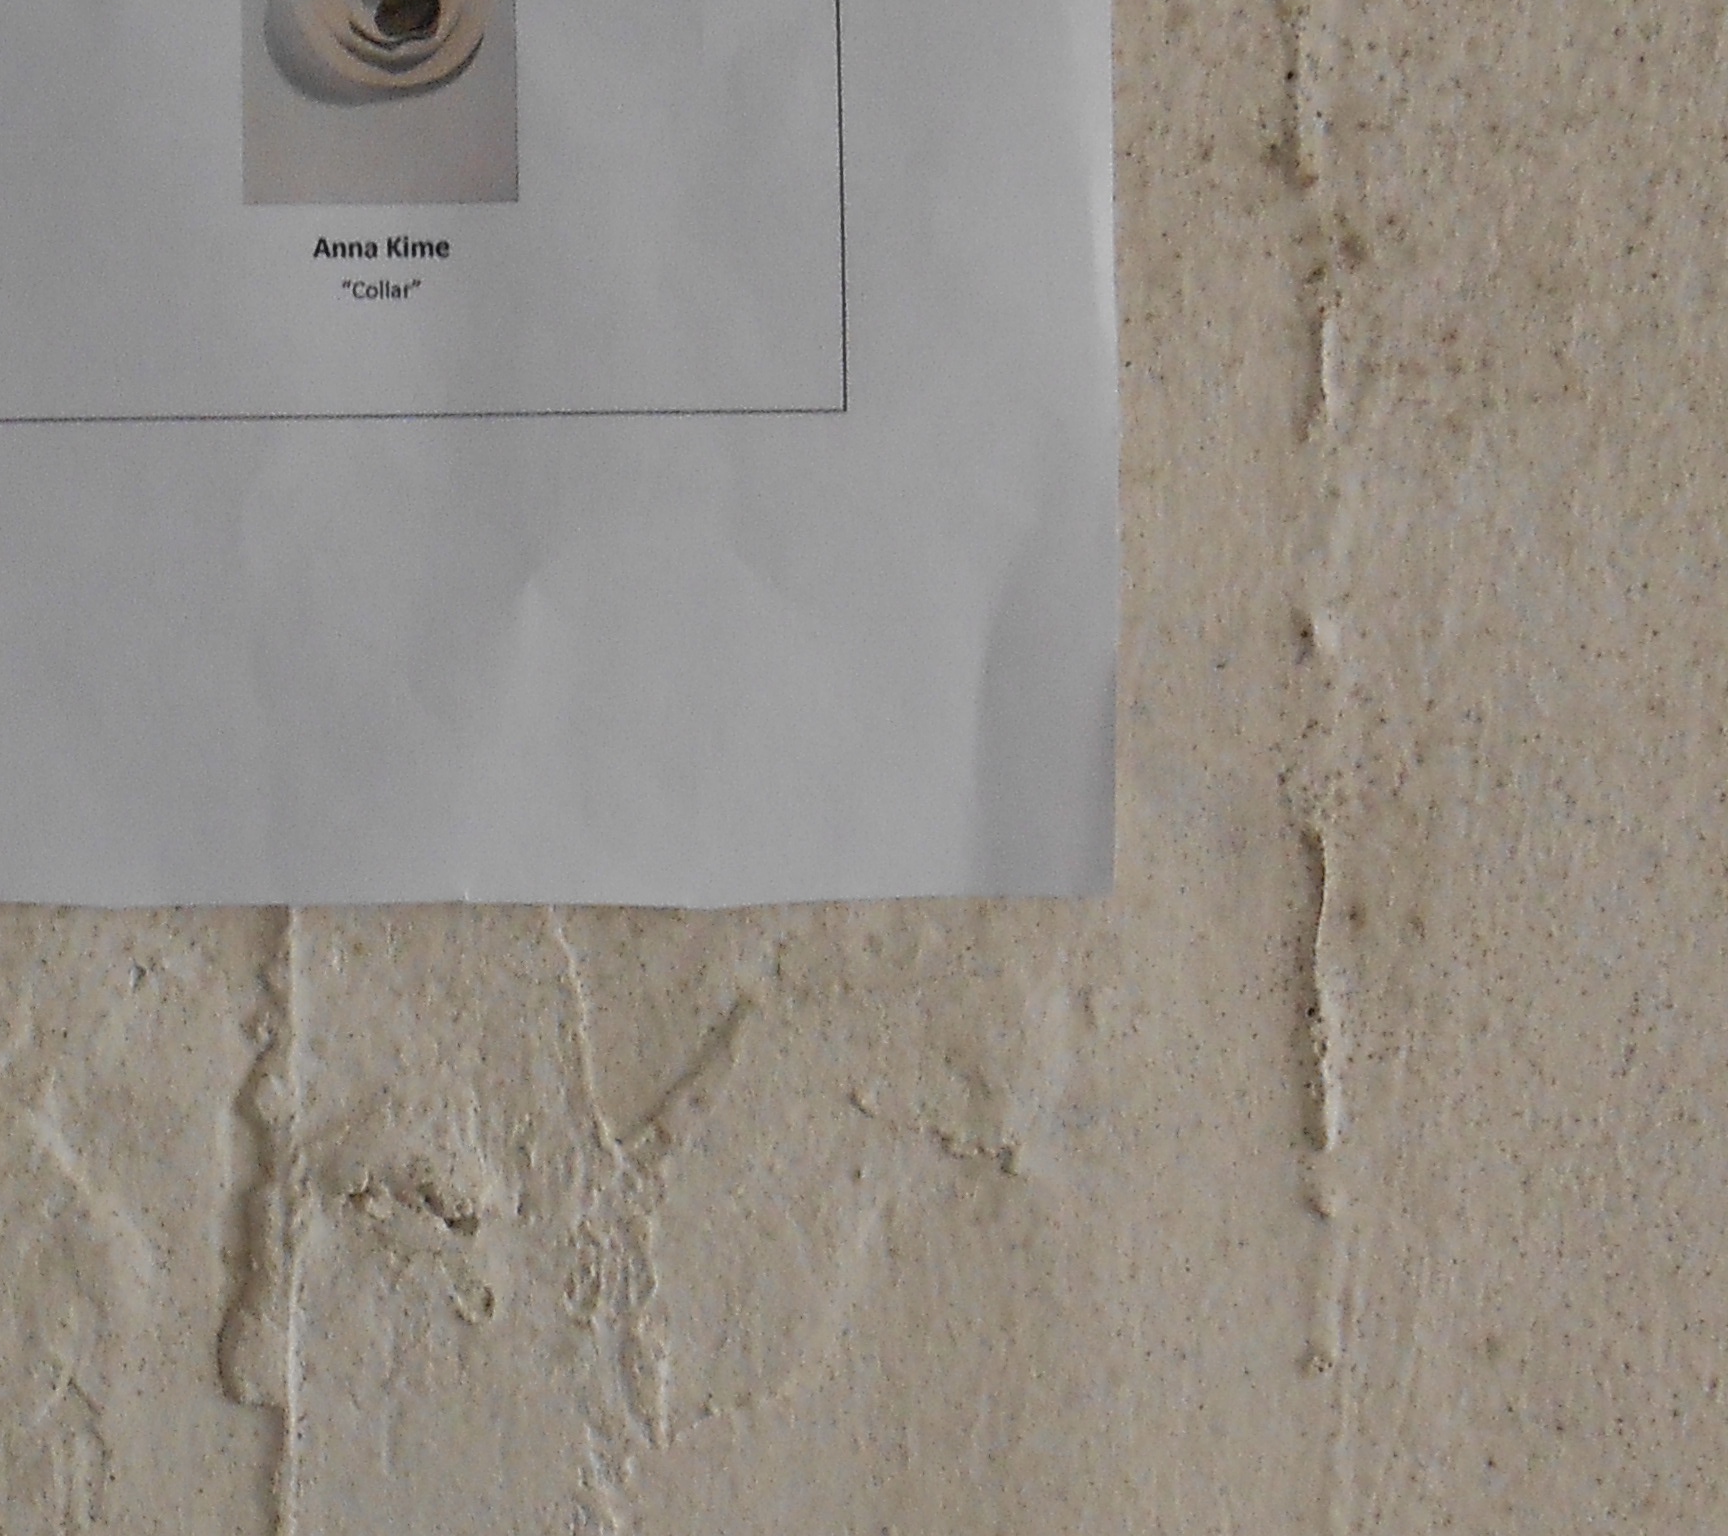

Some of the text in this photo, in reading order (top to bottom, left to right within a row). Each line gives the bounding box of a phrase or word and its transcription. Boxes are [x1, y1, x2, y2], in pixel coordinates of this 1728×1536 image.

[312, 235, 451, 260] Anna Kime
[341, 278, 422, 301] “Collar”
